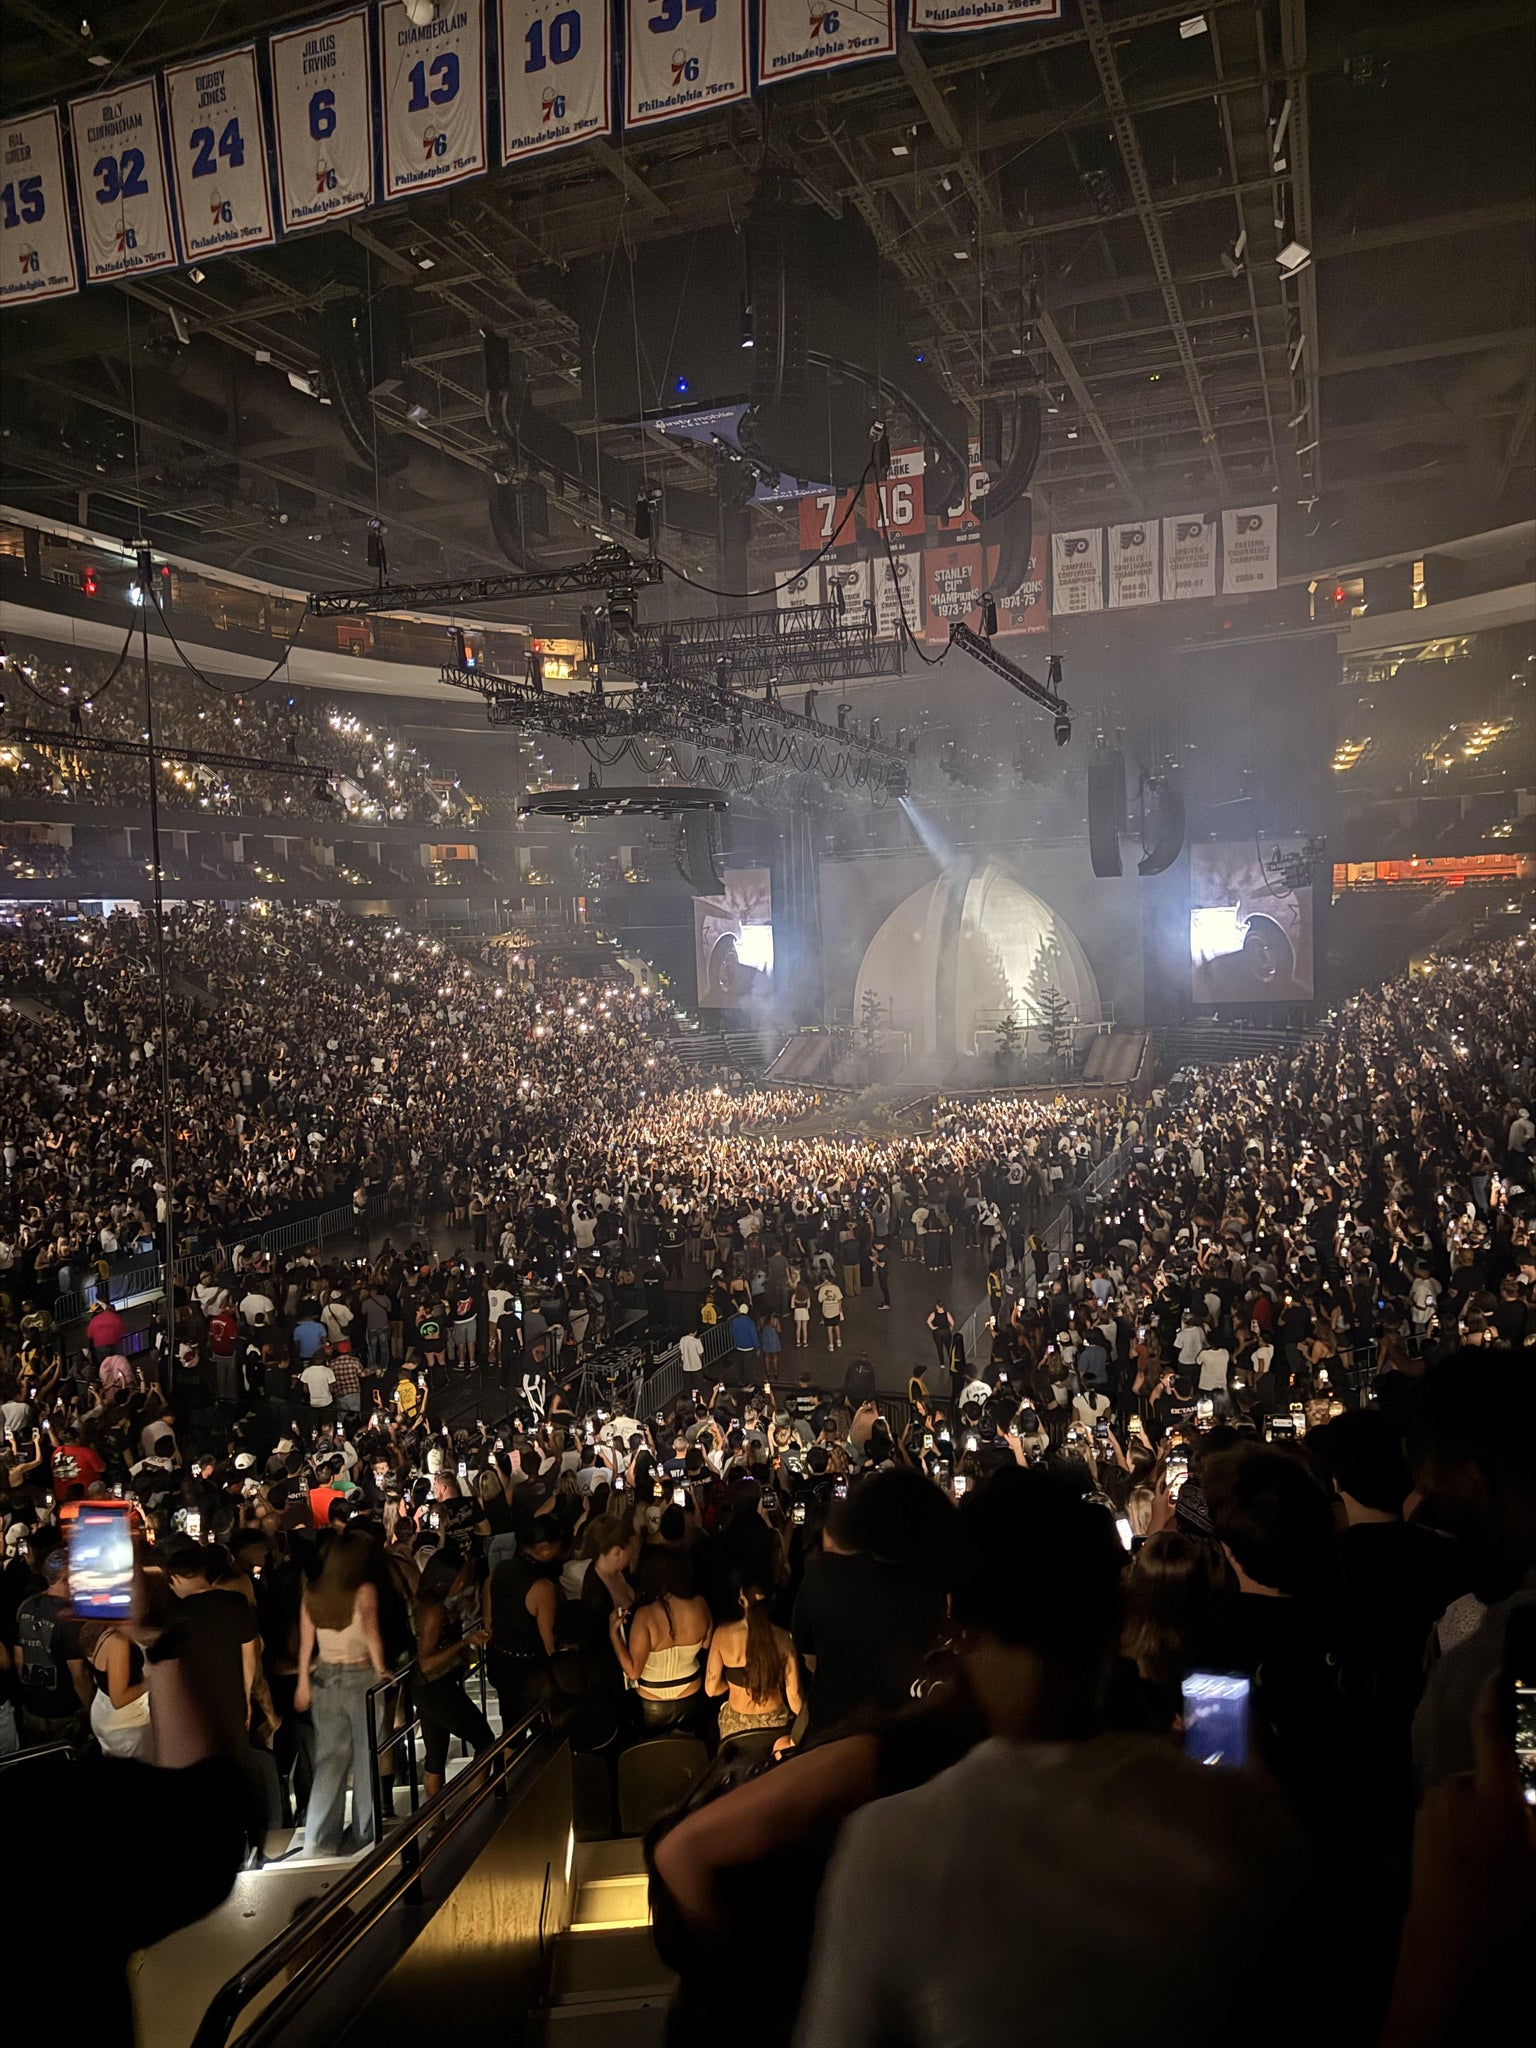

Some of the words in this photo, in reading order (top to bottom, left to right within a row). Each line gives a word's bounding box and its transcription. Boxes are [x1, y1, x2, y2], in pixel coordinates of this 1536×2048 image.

[810, 10, 840, 39] 76
[925, 6, 1004, 19] Philadelphia
[398, 12, 467, 47] CHAMBERLAIN
[525, 9, 581, 73] 10
[303, 34, 335, 58] JULIUS
[772, 42, 844, 67] Philadelphia
[847, 35, 880, 50] 76ers
[303, 52, 336, 75] ERVING
[671, 58, 700, 87] 76
[196, 70, 225, 91] BOBBY
[408, 52, 459, 112] 13
[198, 87, 226, 108] JONES
[542, 95, 566, 123] 76
[638, 90, 703, 113] Philadelphia
[705, 82, 735, 96] 76ers
[308, 88, 336, 141] 6
[87, 113, 142, 142] CUNNINGHAM
[511, 127, 570, 149] Philadelphia
[573, 117, 598, 131] 76ers
[190, 118, 244, 178] 24
[423, 134, 447, 160] 76
[93, 148, 148, 204] 32
[316, 168, 337, 194] 76
[395, 164, 450, 186] Philadelphia
[453, 156, 477, 169] 76ers
[1, 175, 45, 229] 15
[210, 201, 232, 226] 76
[291, 199, 341, 219] Philadelphia
[116, 229, 137, 251] 76
[190, 230, 239, 250] Philadelphia
[240, 226, 262, 238] 76ers
[19, 251, 39, 274] 76
[95, 256, 144, 274] Philadelphia
[694, 412, 734, 423] mobile
[888, 464, 910, 477] ARKE
[816, 496, 836, 537] 7
[877, 483, 913, 528] 16
[934, 565, 972, 582] STANLEY
[884, 586, 911, 595] ATLATIC
[929, 588, 980, 606] CHAMPIONS
[1000, 593, 1036, 608] 1974-75
[938, 601, 972, 617] 1973-74
[1170, 1405, 1198, 1415] OCTAN
